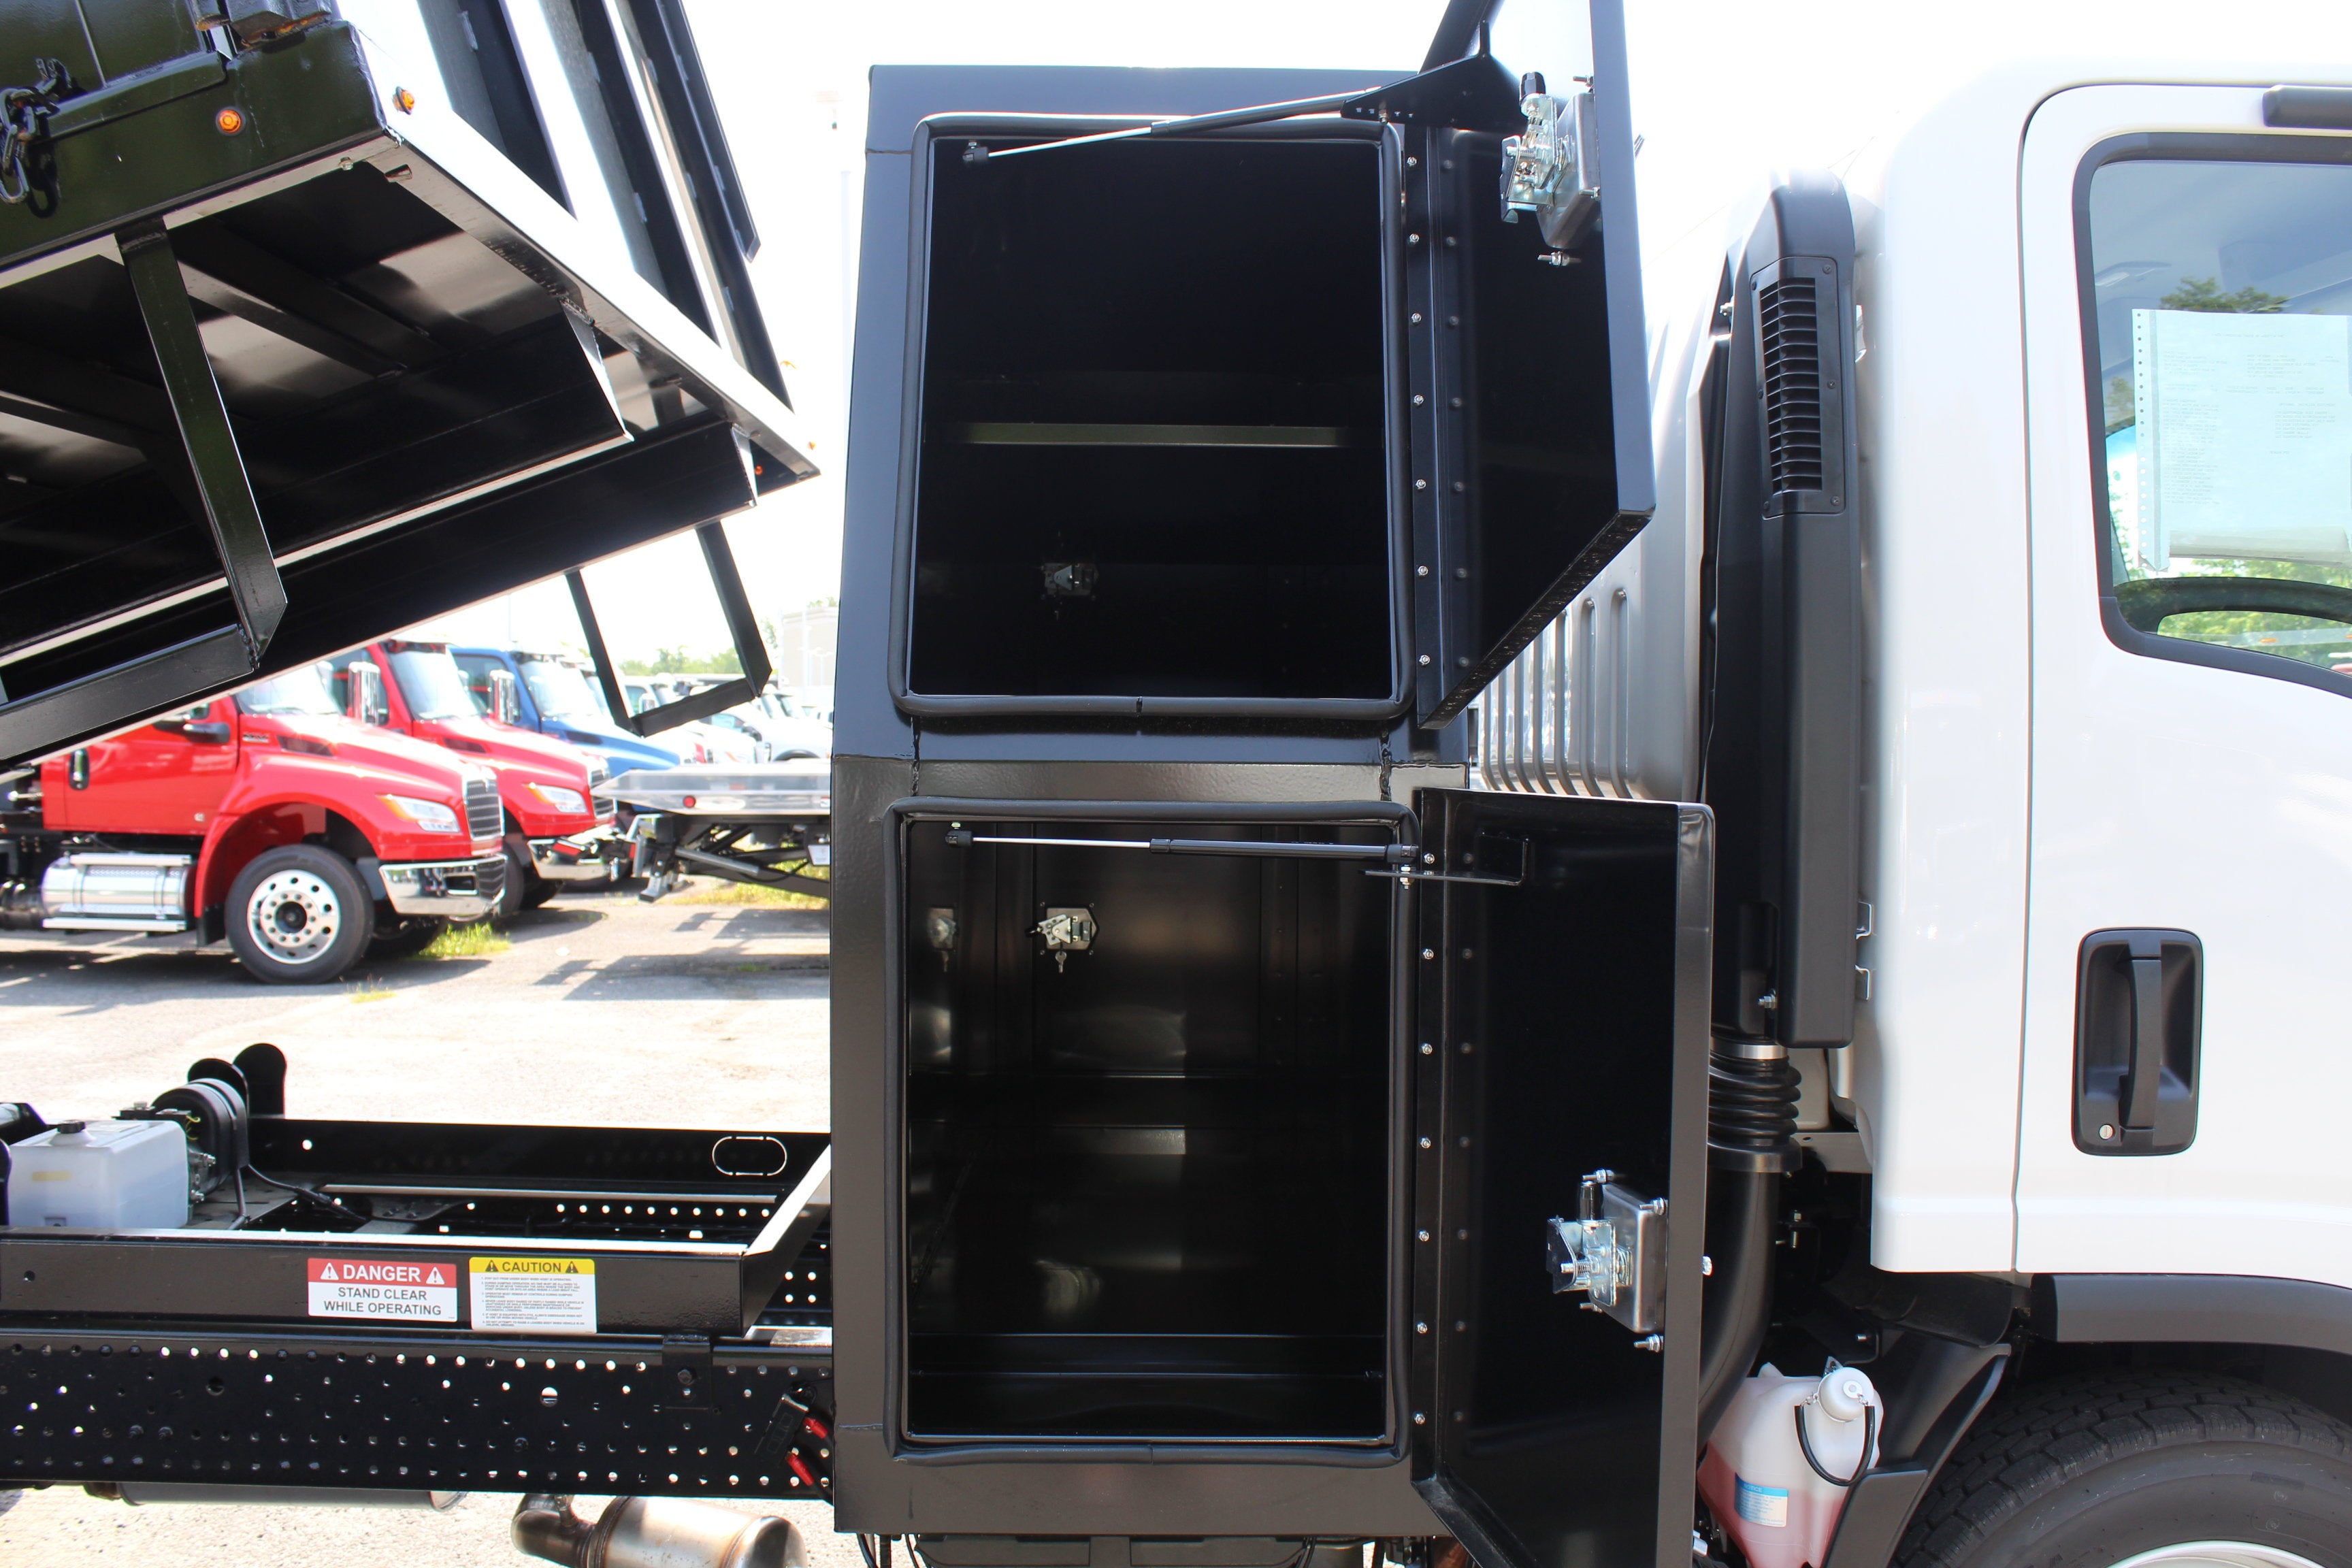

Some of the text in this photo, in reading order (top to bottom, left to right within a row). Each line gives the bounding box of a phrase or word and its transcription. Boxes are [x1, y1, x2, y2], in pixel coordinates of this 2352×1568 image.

[343, 1264, 421, 1283] DANGER
[502, 1262, 561, 1272] CAUTION
[338, 1287, 427, 1301] STAND CLEAR
[323, 1301, 442, 1316] WHILE OPERATING
